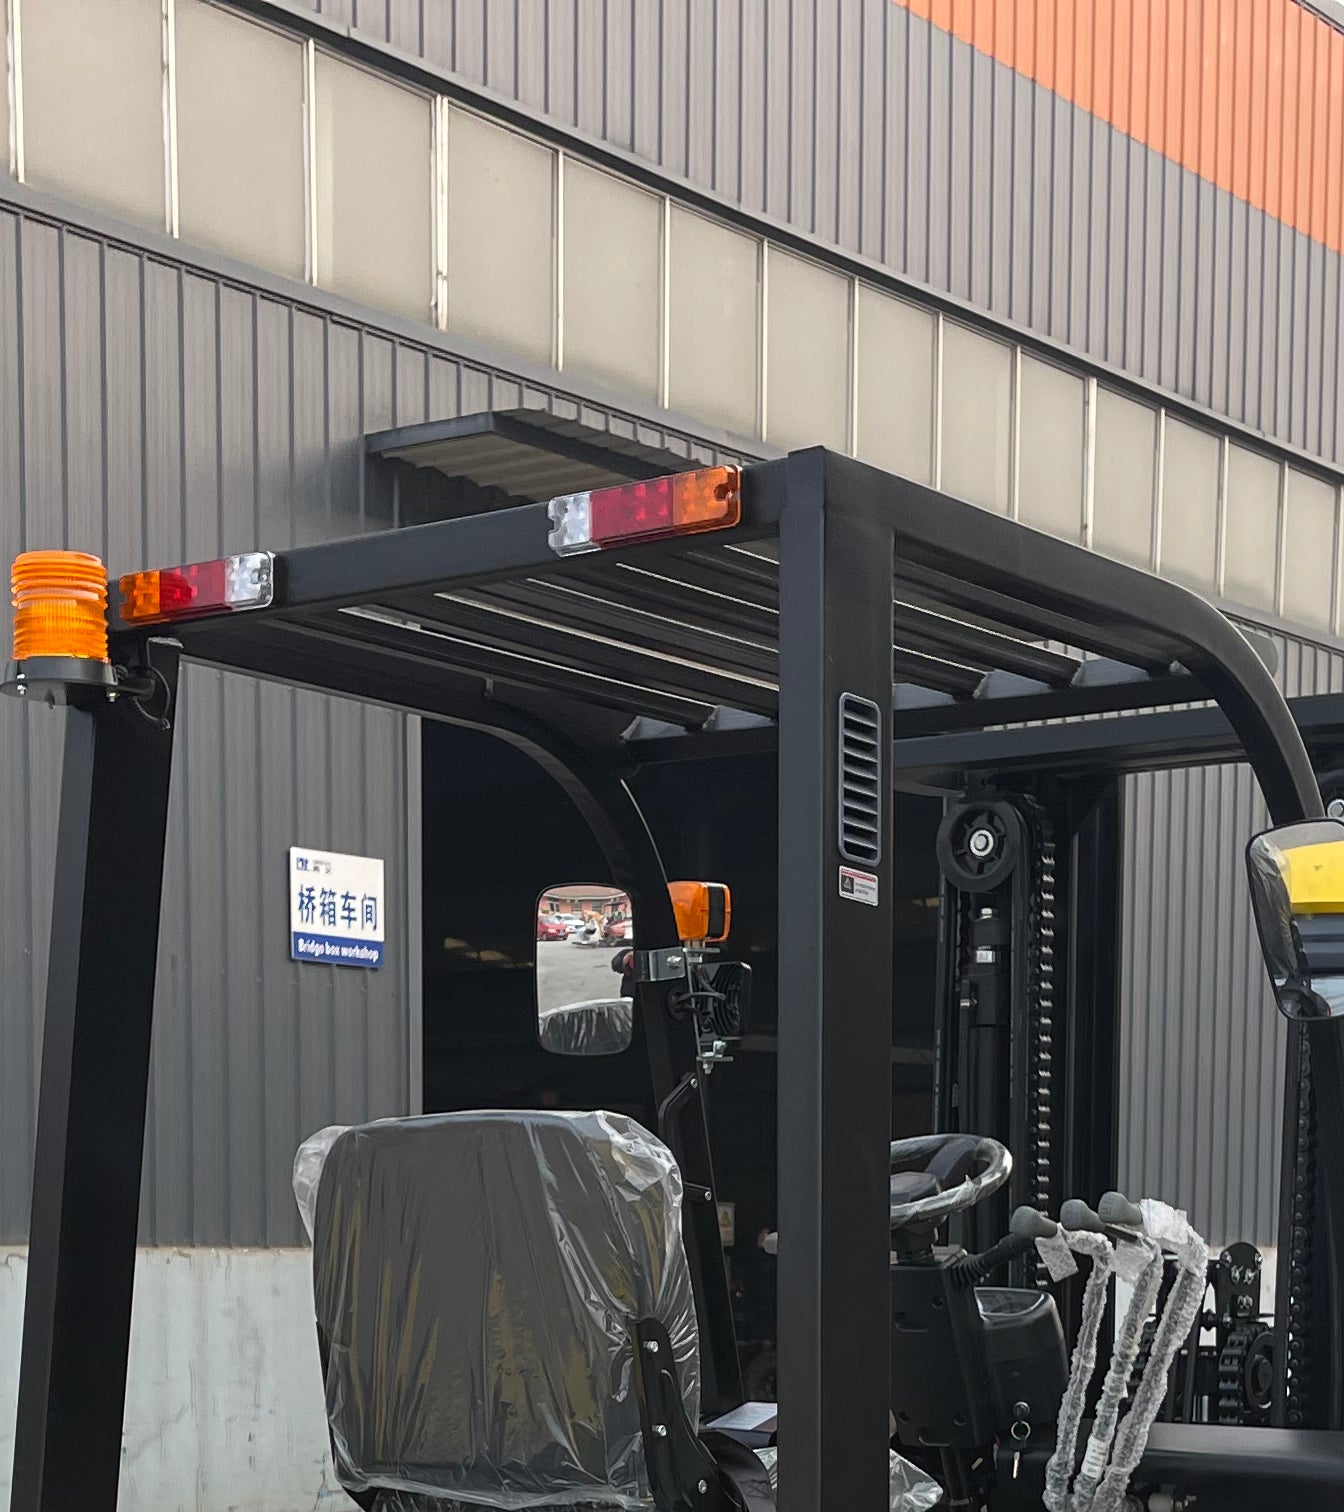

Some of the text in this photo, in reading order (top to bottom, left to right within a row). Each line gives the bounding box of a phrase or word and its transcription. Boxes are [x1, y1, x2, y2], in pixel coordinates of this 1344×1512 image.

[298, 884, 377, 931] 桥箱车间
[297, 938, 379, 963] Bridge box workshop
